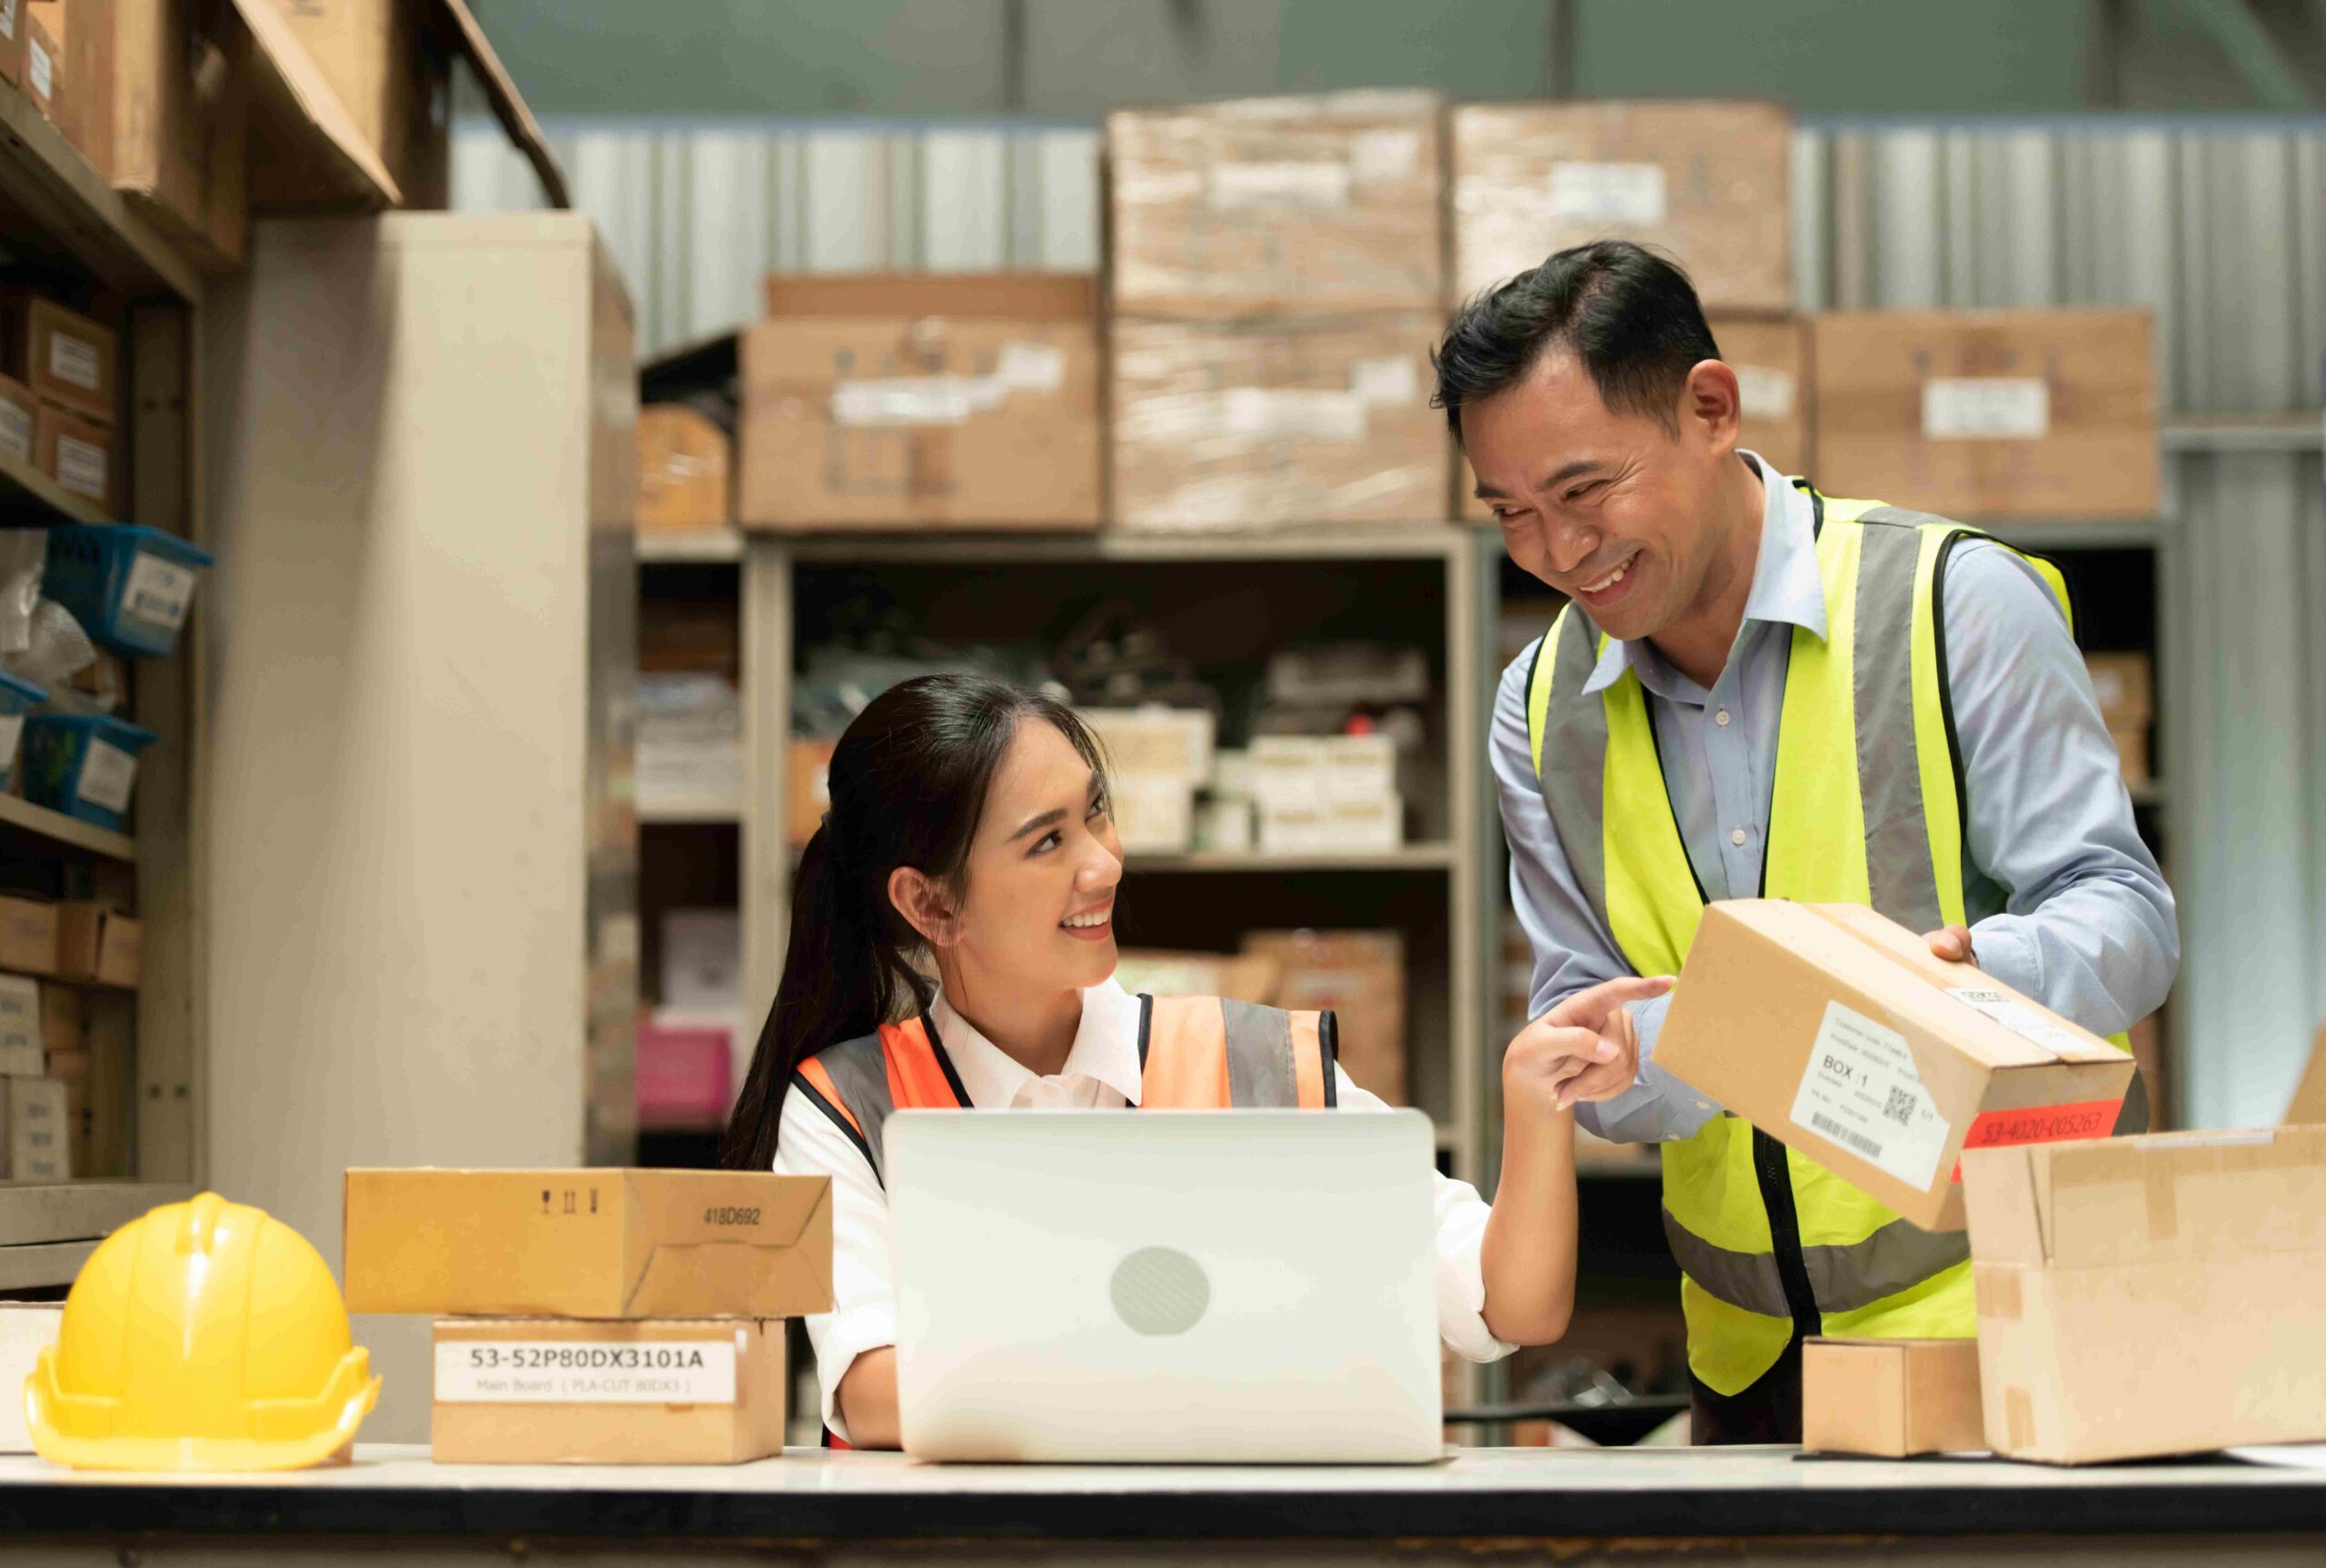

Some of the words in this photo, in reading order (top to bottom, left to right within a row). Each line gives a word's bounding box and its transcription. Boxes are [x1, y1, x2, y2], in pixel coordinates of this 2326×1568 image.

[1823, 1054, 1854, 1080] BOX
[1981, 1110, 2102, 1145] 53-4020-005263
[702, 1206, 761, 1226] 418D692
[470, 1348, 705, 1369] 53-52P80DX3101A
[475, 1378, 508, 1392] Main
[512, 1378, 552, 1392] Board
[572, 1378, 631, 1392] PLA-CUT
